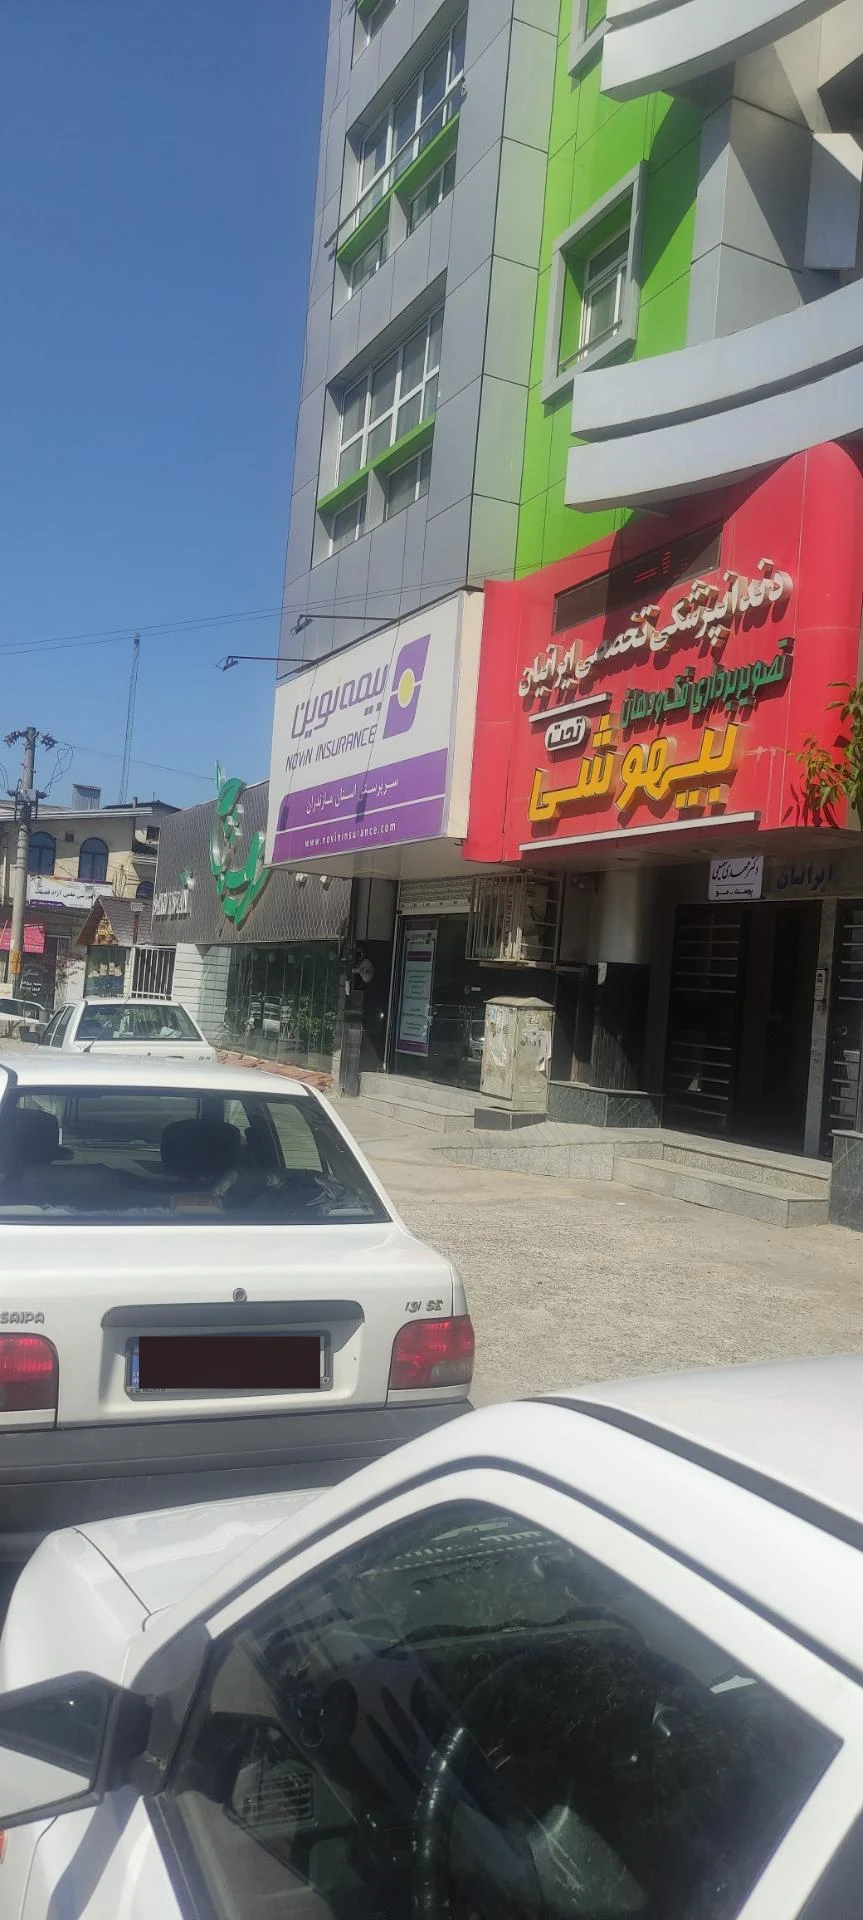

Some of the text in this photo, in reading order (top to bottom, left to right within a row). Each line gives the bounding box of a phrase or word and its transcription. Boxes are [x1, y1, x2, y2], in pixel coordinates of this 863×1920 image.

[519, 557, 787, 698] دندانپزشکی تخصصی ایرانیان
[663, 666, 694, 711] فک
[690, 637, 792, 714] تصویربرداری
[291, 664, 389, 739] بیمه نوین
[315, 723, 378, 761] INSURANCE
[549, 719, 583, 746] تحت
[528, 712, 741, 823] بیهوشی
[306, 791, 333, 815] مازندران
[335, 784, 357, 807] استان
[304, 822, 396, 847] www.novininsurance.com
[0, 1311, 45, 1324] SAIPA
[404, 1299, 444, 1313] 131 SE
